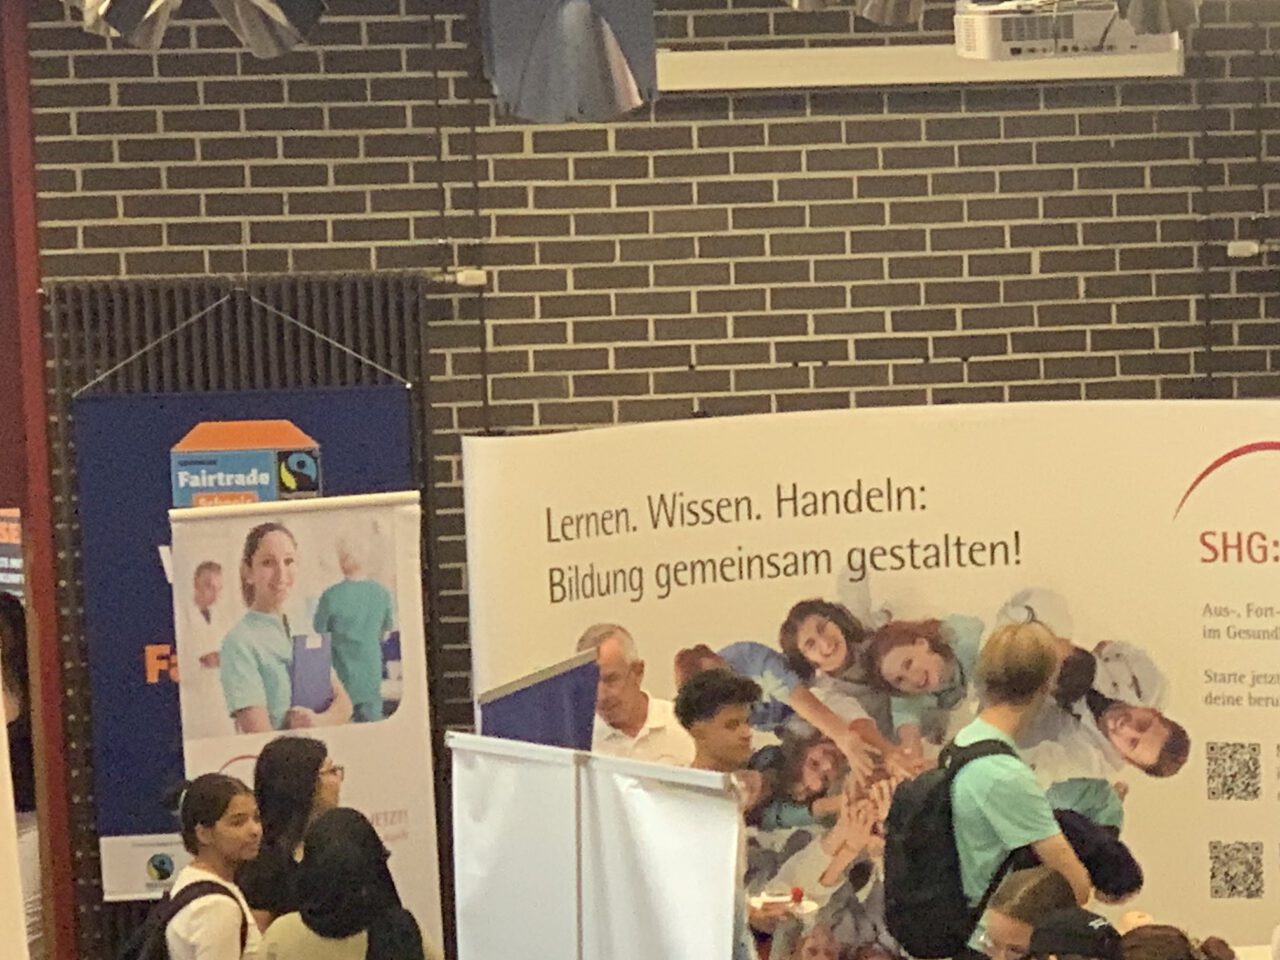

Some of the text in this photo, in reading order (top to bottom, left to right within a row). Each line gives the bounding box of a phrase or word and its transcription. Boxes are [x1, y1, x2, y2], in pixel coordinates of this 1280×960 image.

[177, 467, 270, 489] Fairtrade
[546, 477, 927, 543] Lernen. Wissen. Handeln:
[1199, 530, 1280, 564] SHG:
[549, 530, 1022, 604] Bildung gemeinsam gestalten!
[1245, 602, 1280, 619] Fort-
[1202, 625, 1221, 640] im
[1203, 669, 1247, 685] Starte
[1249, 670, 1280, 688] jetzt
[1204, 691, 1243, 707] deine
